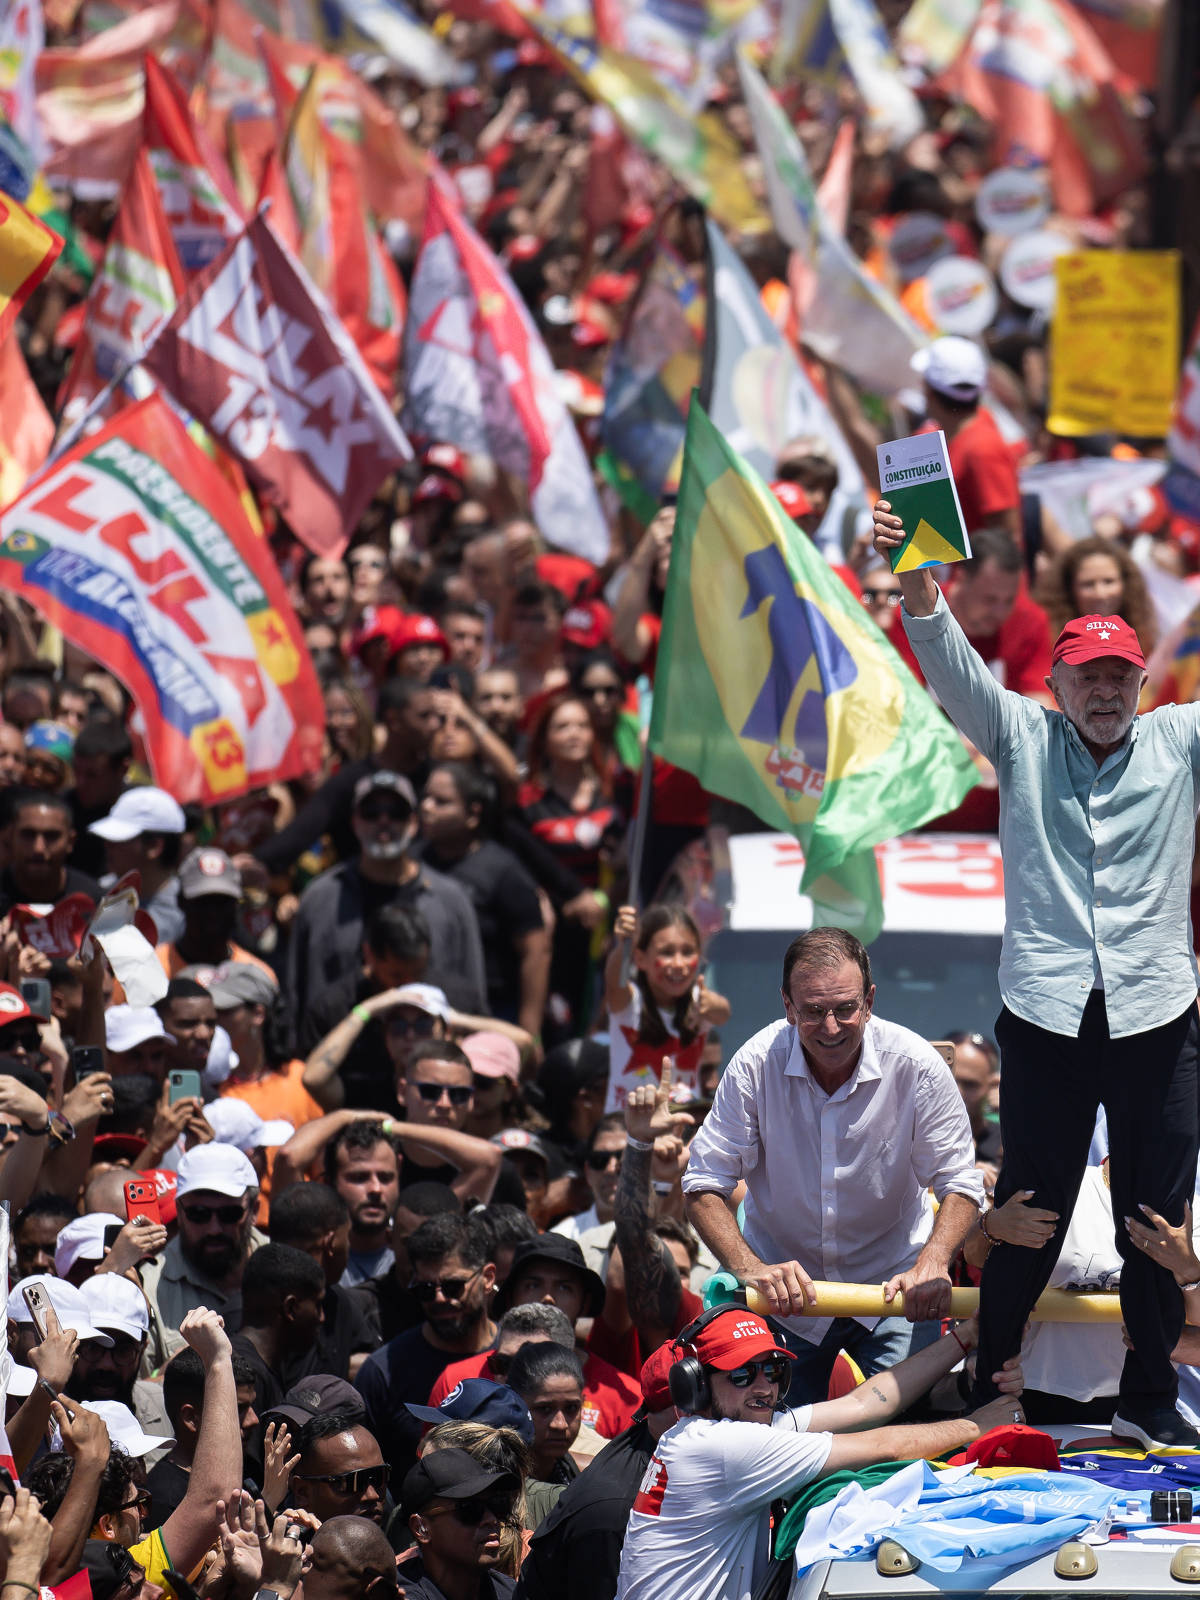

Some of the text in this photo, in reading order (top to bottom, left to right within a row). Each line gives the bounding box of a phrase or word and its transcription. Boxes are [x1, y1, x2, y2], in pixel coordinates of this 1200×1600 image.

[885, 461, 942, 484] CONSTITUIÇÃO
[94, 441, 268, 608] PRESIDENTE
[28, 474, 268, 730] LULA
[1086, 621, 1120, 631] SILVA
[205, 727, 245, 770] 13
[732, 1327, 767, 1339] SILVA
